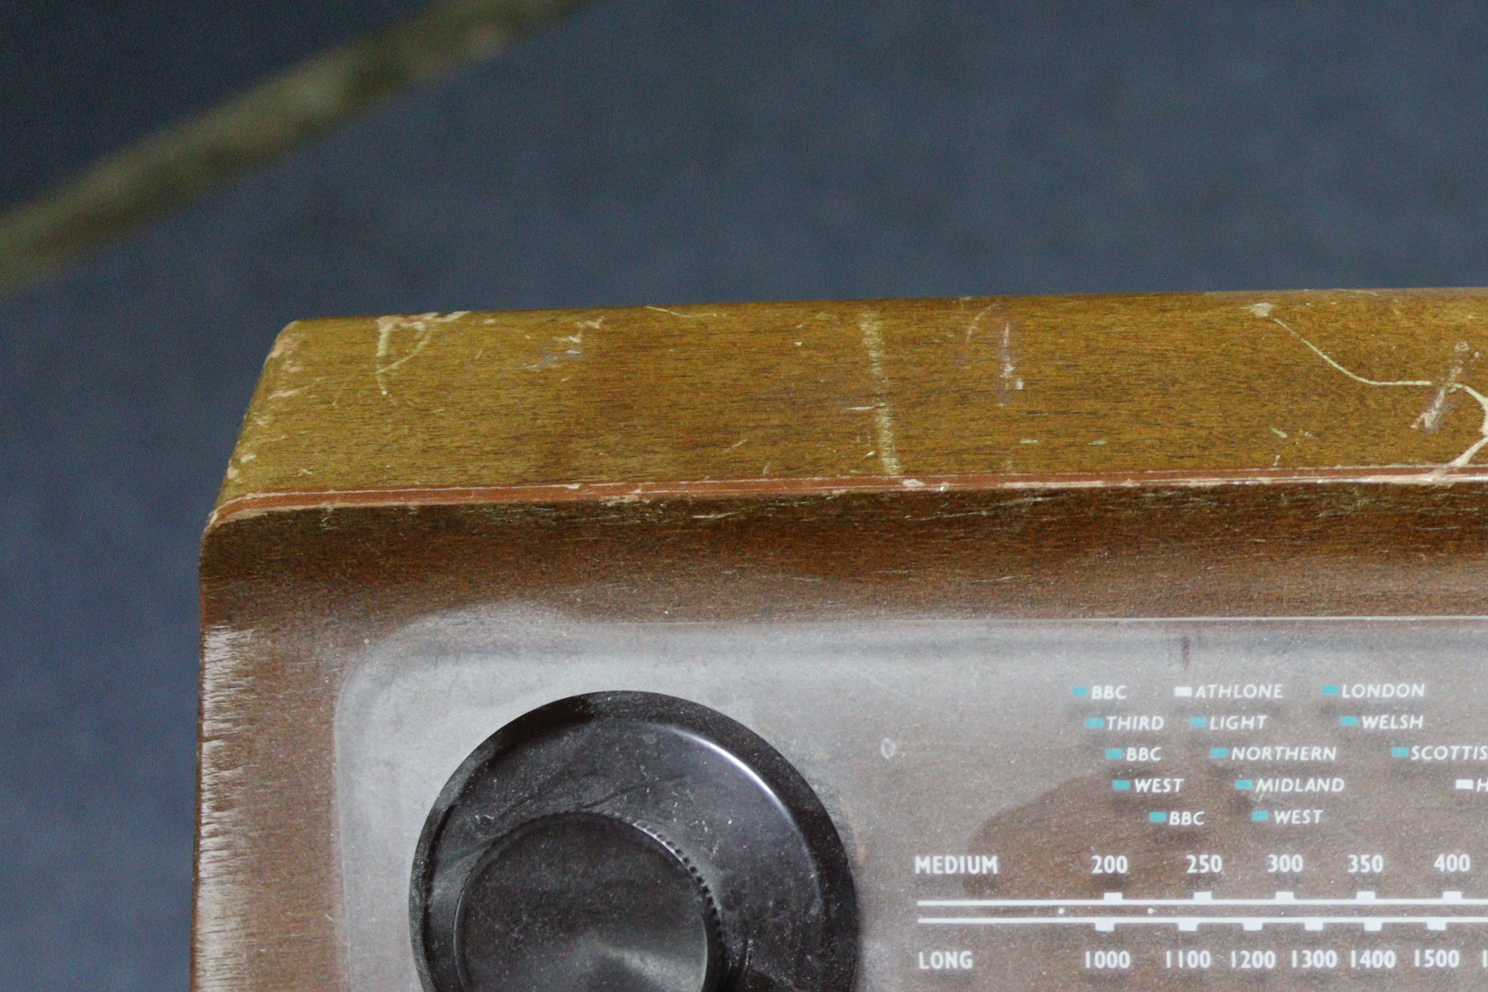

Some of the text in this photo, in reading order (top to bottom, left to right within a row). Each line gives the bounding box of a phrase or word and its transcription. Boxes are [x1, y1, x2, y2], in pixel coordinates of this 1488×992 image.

[1091, 684, 1127, 700] BBC
[1194, 683, 1283, 699] ATHLONE
[1341, 683, 1425, 699] LONDON
[1106, 715, 1165, 731] THIRD
[1209, 714, 1268, 731] LIGHT
[1361, 714, 1424, 730] WELSH
[1126, 746, 1162, 762] BBC
[1231, 745, 1337, 761] NORTHERN
[1134, 777, 1185, 793] WEST
[1255, 777, 1345, 793] MIDLAND
[1169, 810, 1205, 826] BBC
[1273, 809, 1324, 825] WEST
[914, 854, 998, 875] MEDIUM
[1091, 854, 1129, 874] 200
[1185, 853, 1223, 874] 250
[1267, 853, 1304, 873] 300
[1347, 853, 1384, 874] 350
[1433, 853, 1471, 873] 400
[918, 950, 974, 970] LONG
[1084, 950, 1131, 969] 1000
[1165, 949, 1212, 969] 1100
[1230, 950, 1277, 970] 1200
[1291, 949, 1339, 969] 1300
[1350, 949, 1397, 969] 1400
[1414, 948, 1461, 969] 1500
